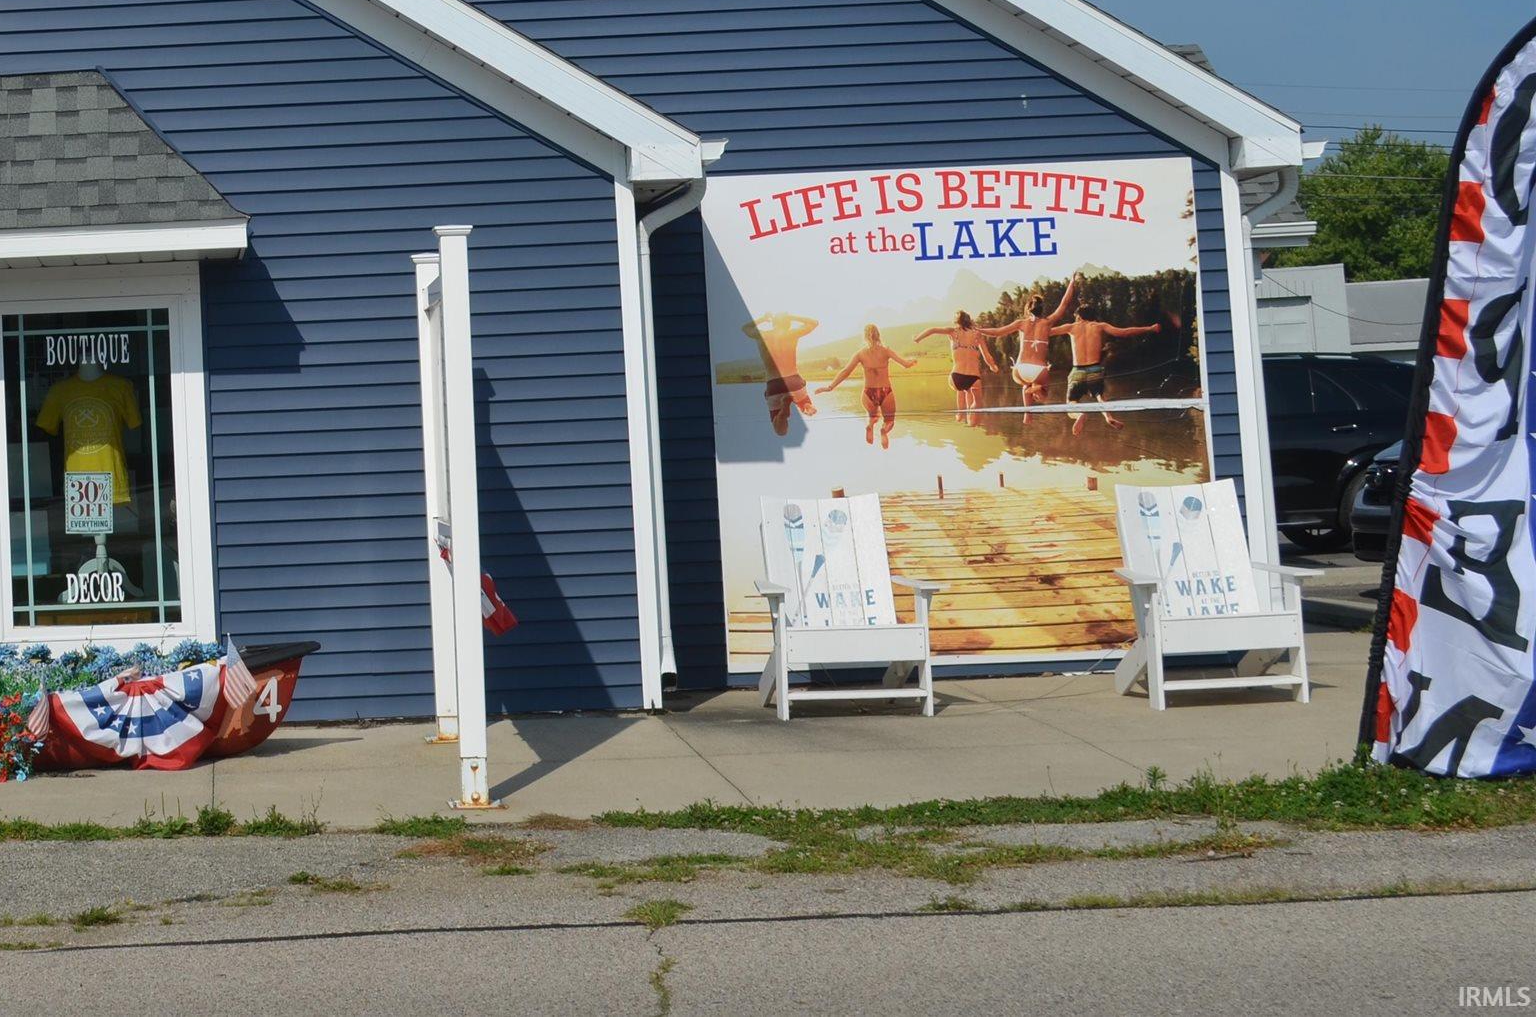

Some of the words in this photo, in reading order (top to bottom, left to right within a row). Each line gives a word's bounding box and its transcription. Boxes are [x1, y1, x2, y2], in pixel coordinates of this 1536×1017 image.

[739, 178, 862, 241] LIFE
[870, 172, 925, 216] IS
[934, 170, 1147, 224] BETTER
[829, 228, 859, 255] at
[865, 226, 916, 254] the
[912, 216, 1059, 262] LAKE
[45, 332, 130, 371] BOUTIQUE
[70, 480, 109, 503] 30%
[70, 503, 109, 518] OFF
[70, 520, 109, 528] EVERYTHING
[66, 571, 125, 604] DECOR
[1175, 575, 1237, 596] WAKE
[253, 676, 282, 723] 4
